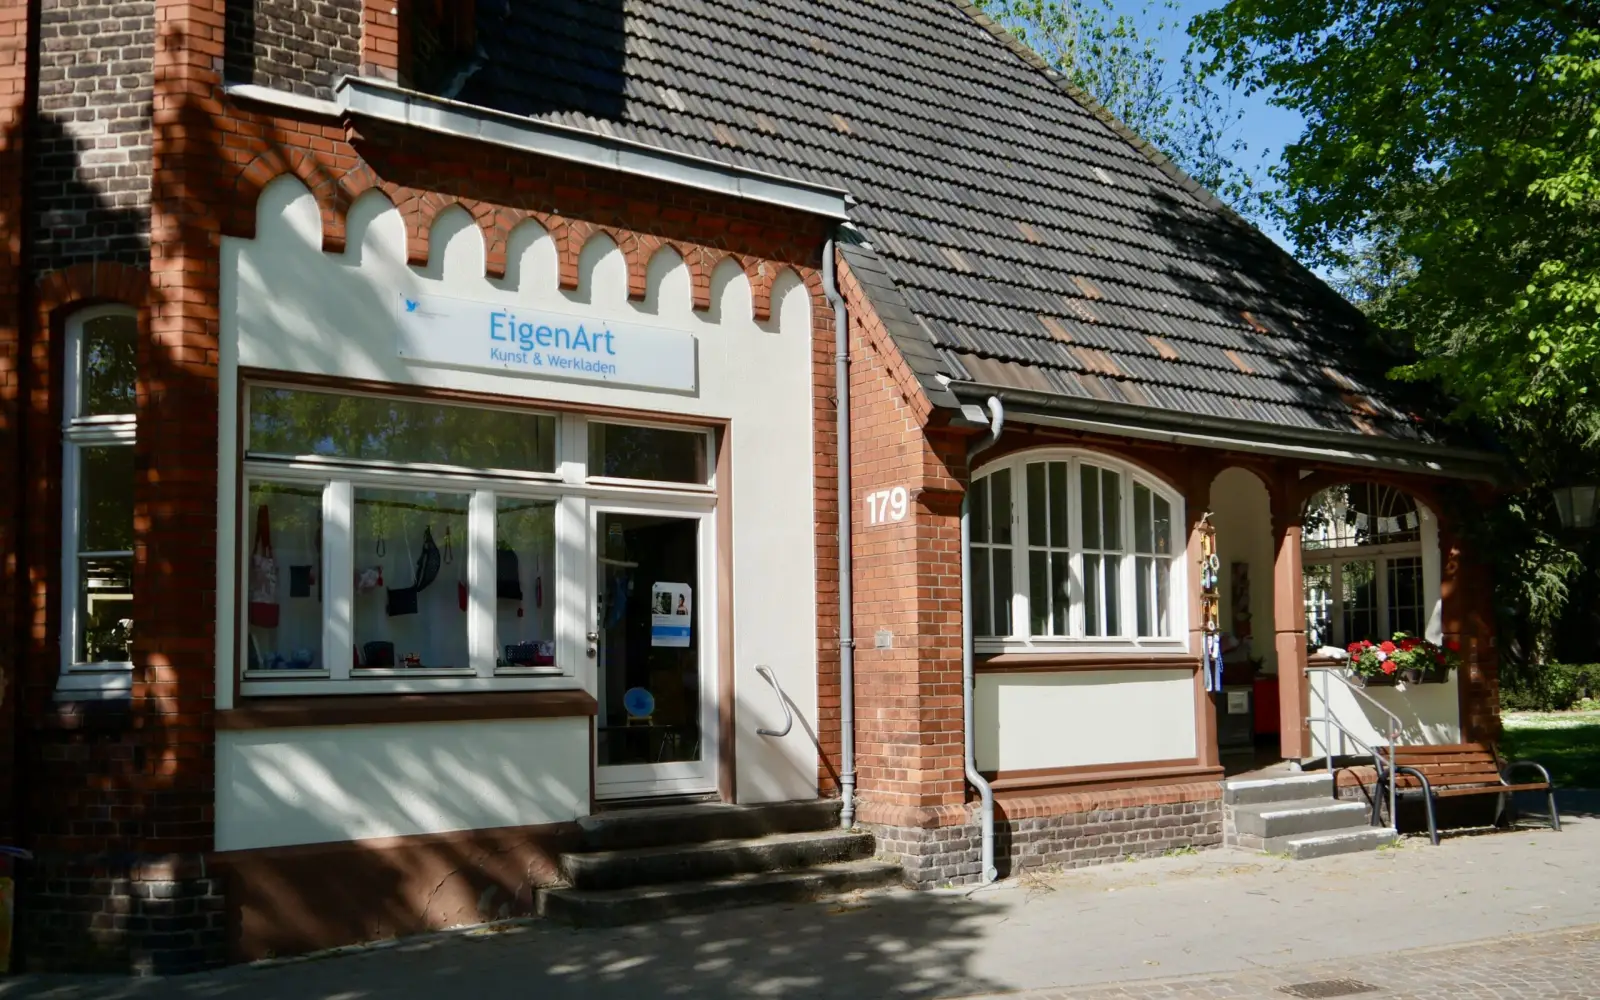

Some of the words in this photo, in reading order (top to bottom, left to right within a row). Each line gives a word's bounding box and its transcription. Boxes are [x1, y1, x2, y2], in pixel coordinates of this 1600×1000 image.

[490, 311, 616, 355] EigenArt
[490, 347, 527, 364] Kunst
[533, 352, 543, 366] &
[547, 354, 616, 375] Werkladen
[867, 486, 907, 524] 179
